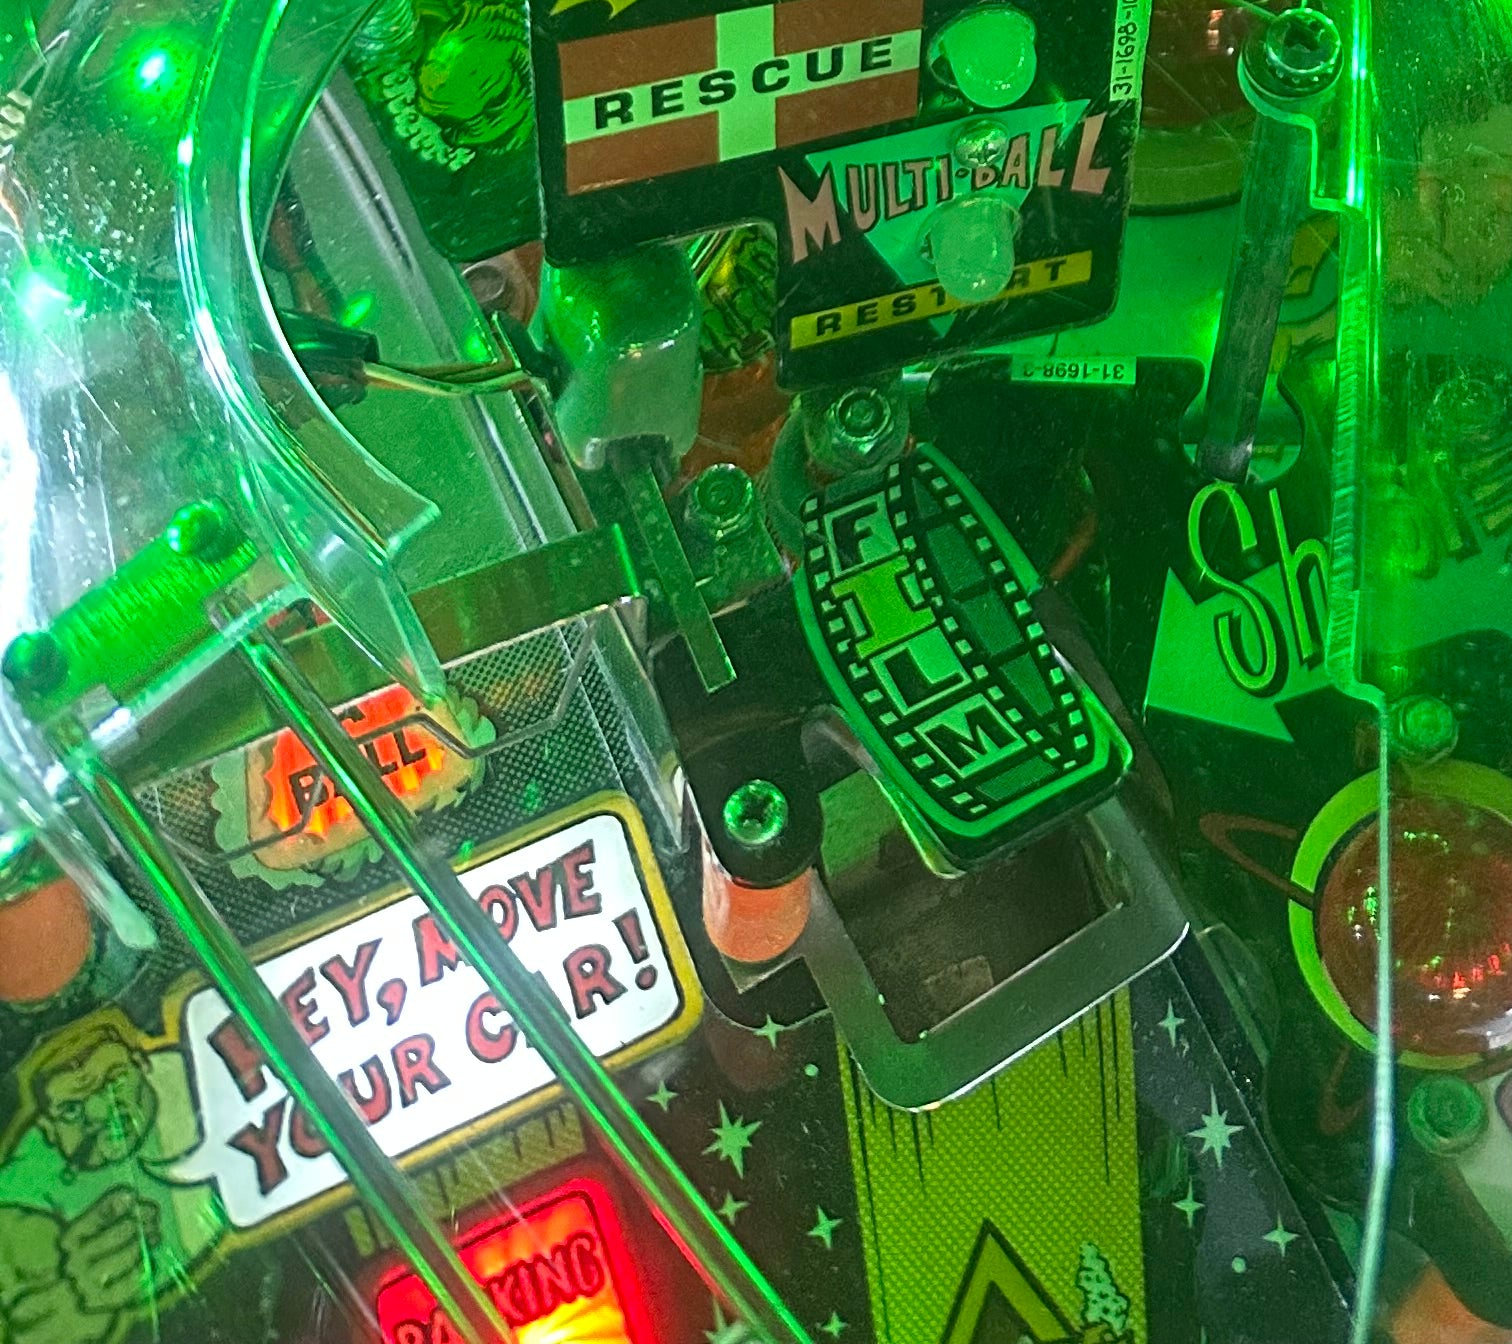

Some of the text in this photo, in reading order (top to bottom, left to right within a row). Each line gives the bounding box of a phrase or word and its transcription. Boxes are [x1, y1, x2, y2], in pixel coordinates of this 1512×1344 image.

[594, 36, 894, 129] RESCUE
[816, 258, 1067, 336] RESTRT
[828, 498, 1020, 773] FILM
[288, 728, 427, 815] BLL
[465, 908, 657, 1064] CR!
